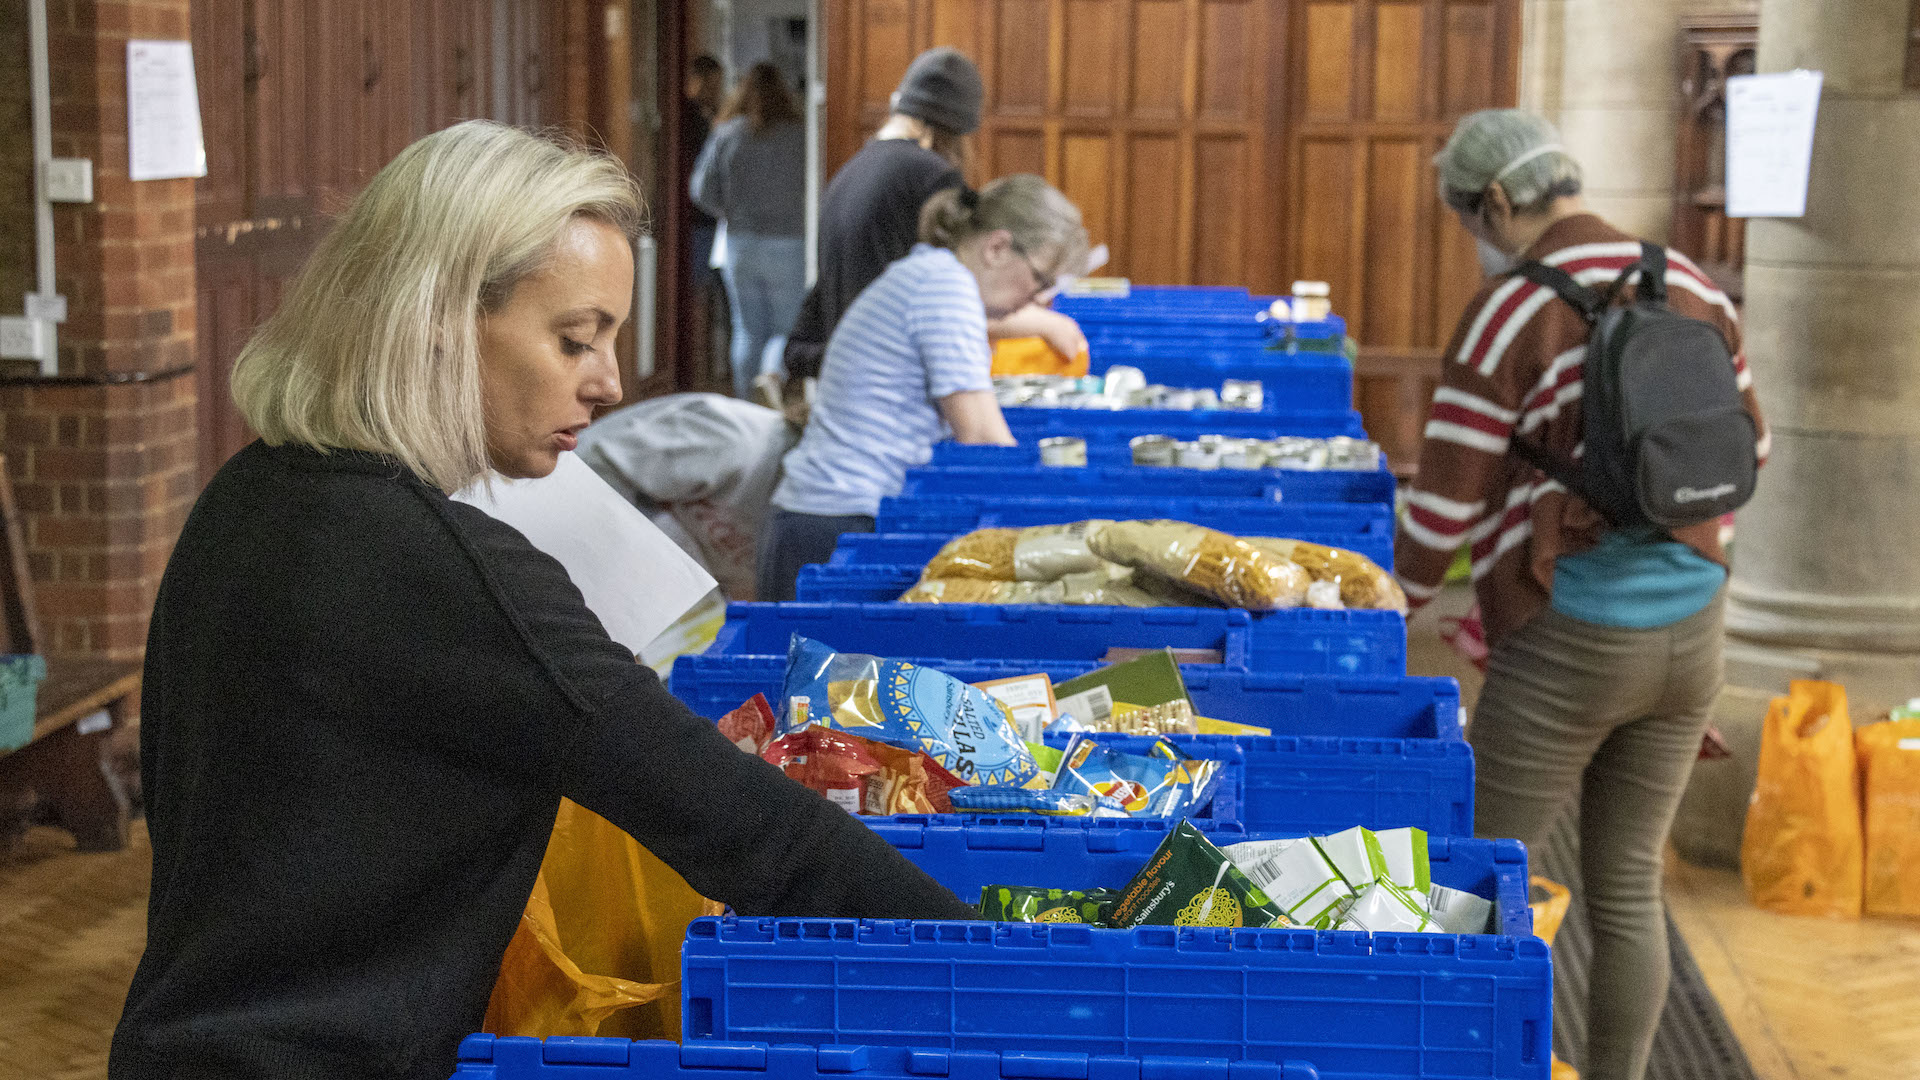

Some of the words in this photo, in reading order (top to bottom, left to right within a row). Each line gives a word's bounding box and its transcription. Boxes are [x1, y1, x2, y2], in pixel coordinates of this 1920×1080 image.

[963, 699, 986, 740] SALTED
[1111, 878, 1148, 921] vegetable
[1145, 849, 1174, 880] flavour
[1117, 902, 1137, 927] instant
[1135, 877, 1161, 905] noodles
[1134, 880, 1176, 925] Sainsbury's
